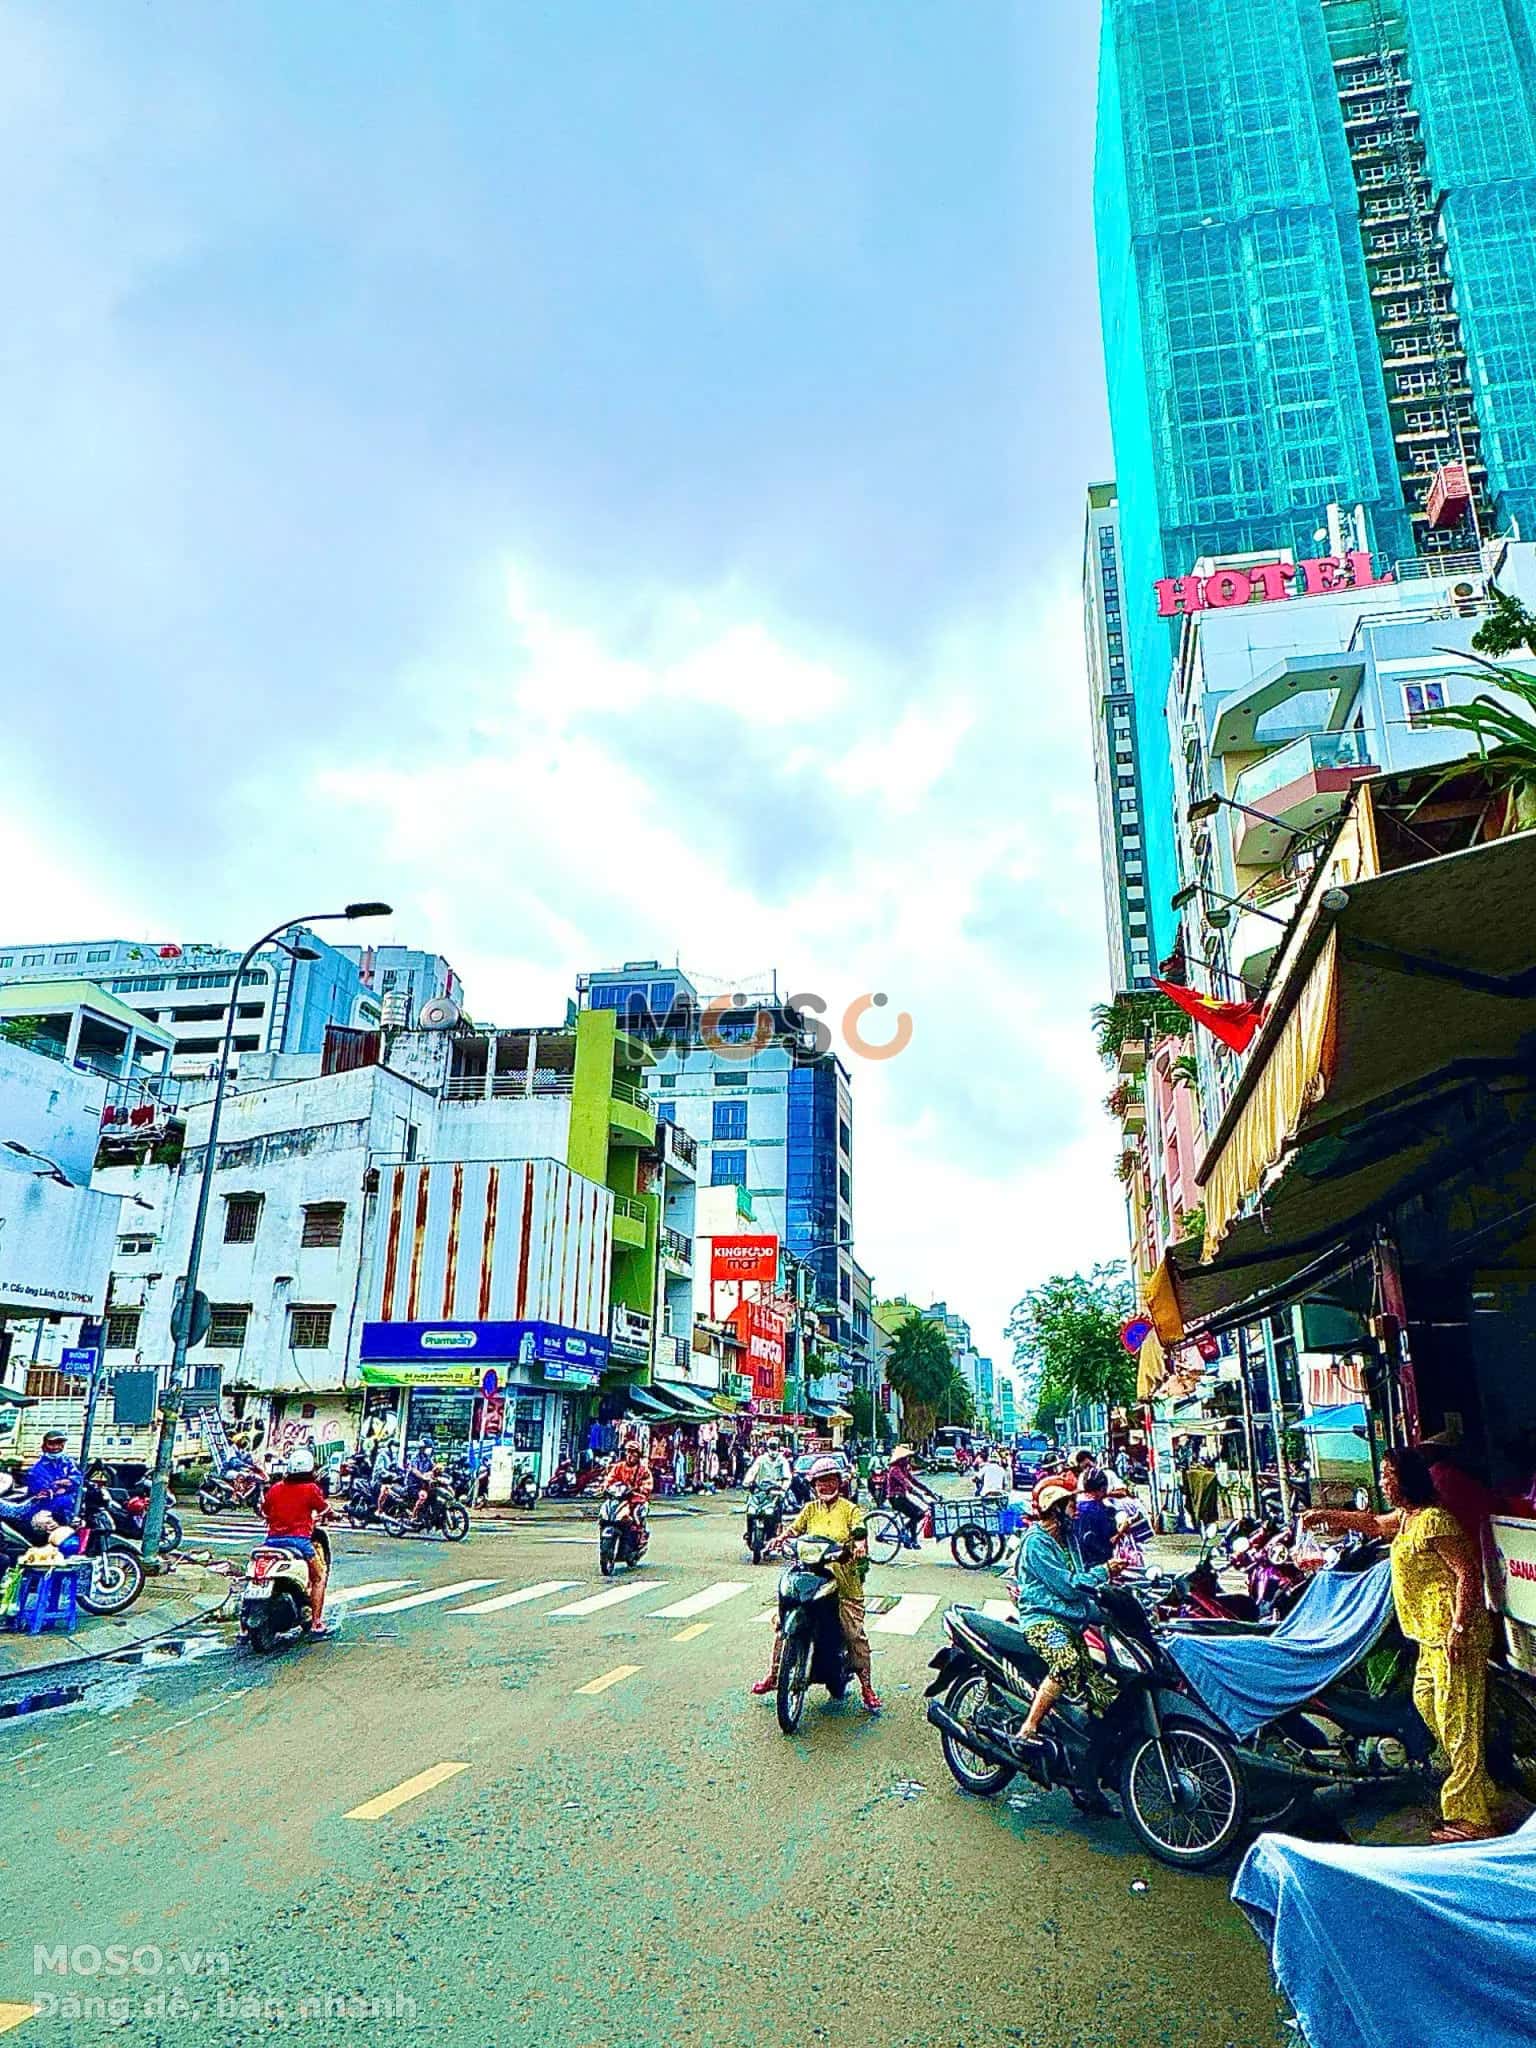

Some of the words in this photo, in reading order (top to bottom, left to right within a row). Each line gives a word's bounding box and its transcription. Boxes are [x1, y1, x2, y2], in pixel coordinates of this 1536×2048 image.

[1152, 551, 1396, 617] HOTEL
[714, 1247, 773, 1258] KINGFOOD
[727, 1258, 759, 1270] mart
[424, 1333, 472, 1346] Pharmacity
[1509, 1559, 1536, 1582] SANA
